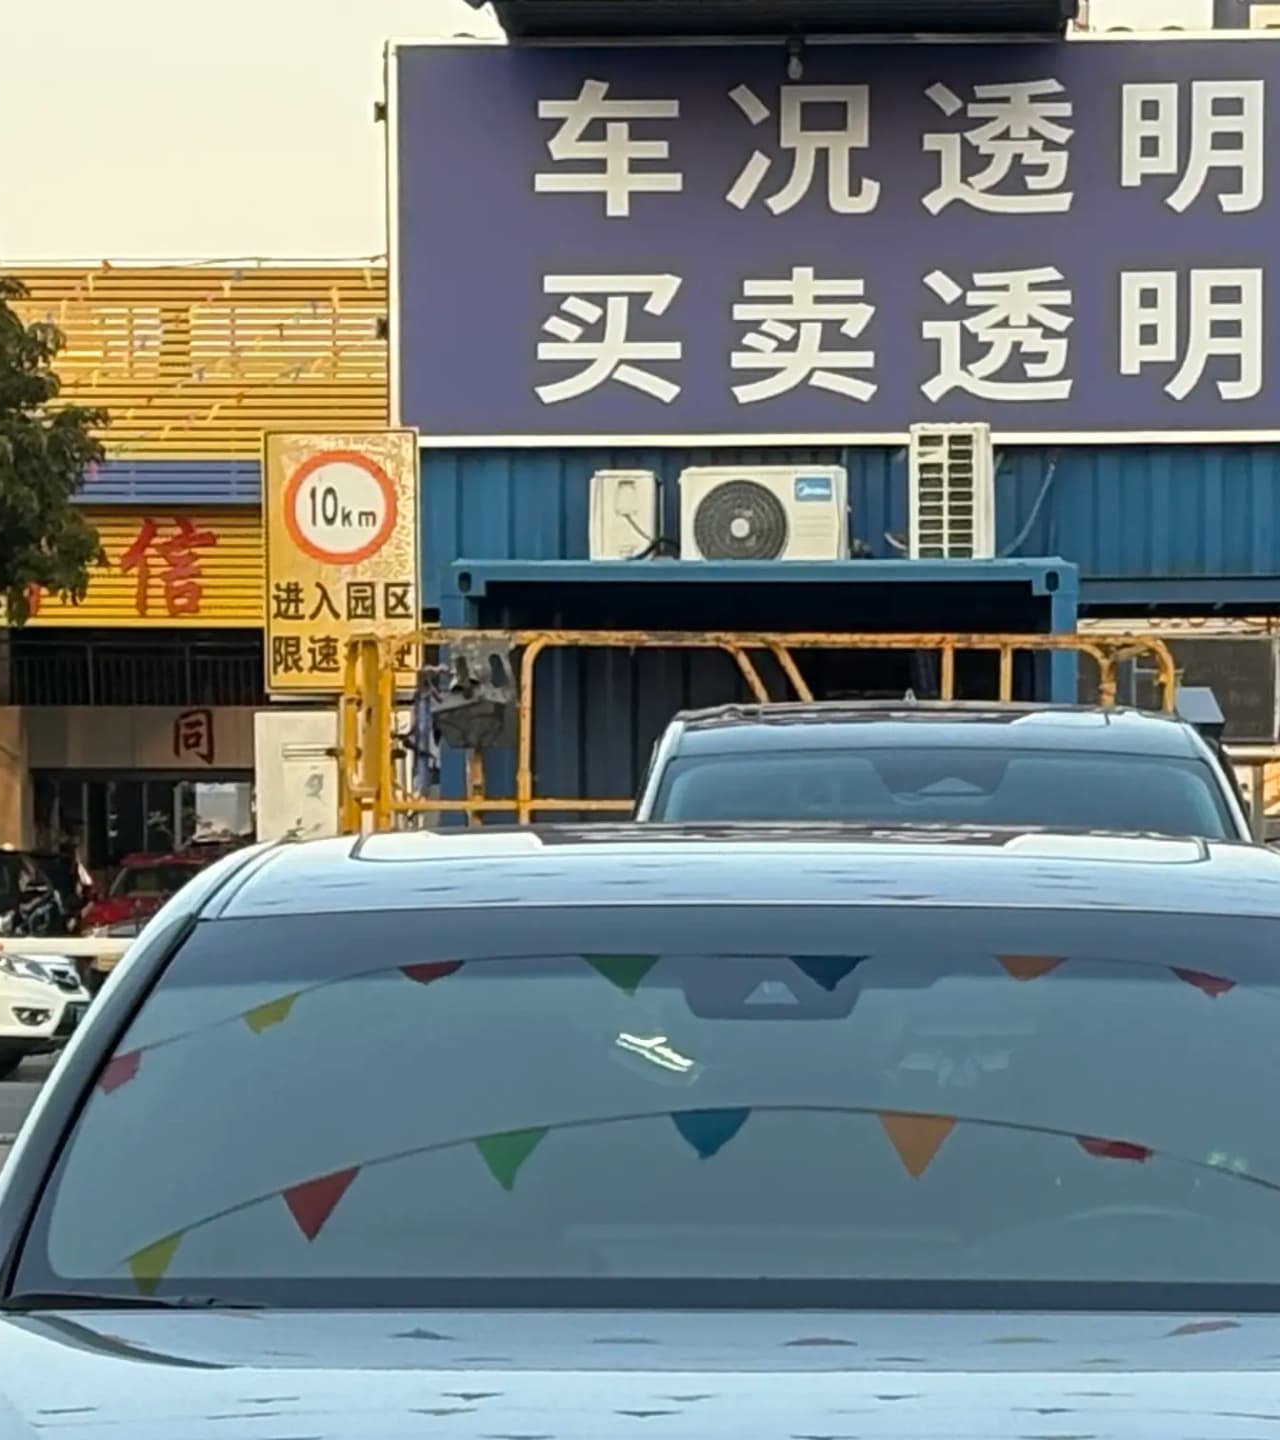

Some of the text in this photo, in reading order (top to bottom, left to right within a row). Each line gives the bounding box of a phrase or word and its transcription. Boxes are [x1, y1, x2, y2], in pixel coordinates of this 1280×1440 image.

[534, 78, 1267, 217] 车况透明
[534, 266, 1267, 404] 买卖透明
[119, 515, 217, 618] 信
[272, 581, 414, 621] 进入园区
[173, 708, 215, 765] 同
